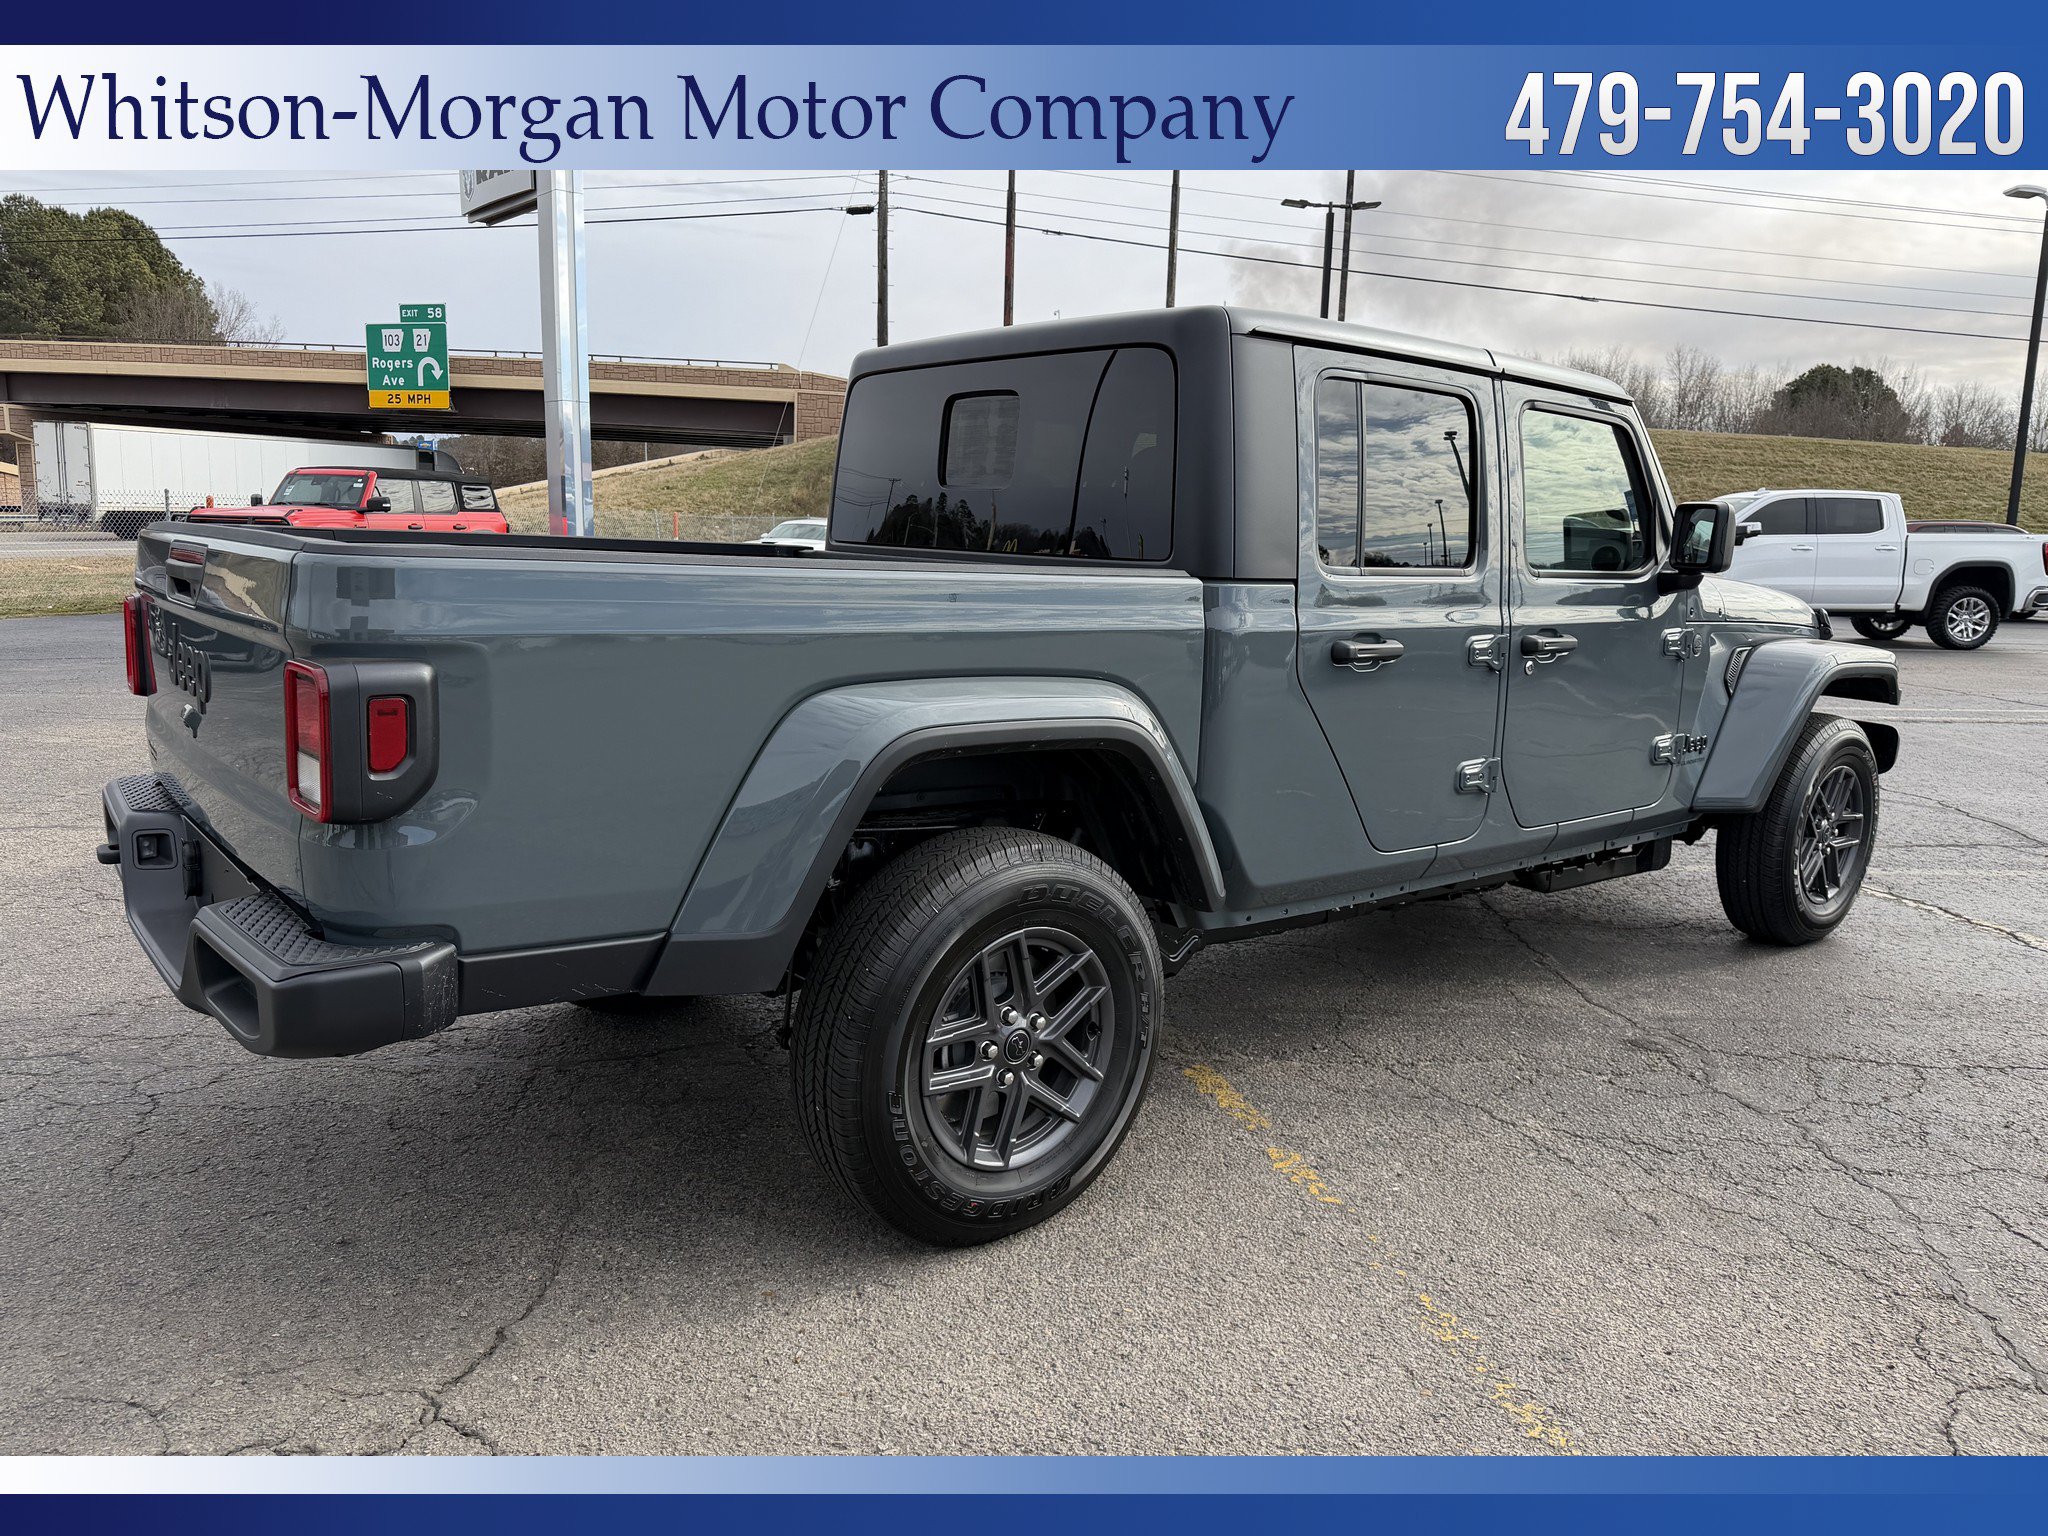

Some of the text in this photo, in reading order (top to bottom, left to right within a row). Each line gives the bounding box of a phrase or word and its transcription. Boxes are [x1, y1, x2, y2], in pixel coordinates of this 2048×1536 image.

[401, 307, 442, 318] EXIT 58
[384, 334, 400, 346] 103
[416, 334, 427, 346] 21
[372, 357, 413, 371] Rogers
[382, 375, 405, 385] Ave
[387, 394, 431, 404] 25 MPH
[1018, 883, 1146, 982] DUELER
[888, 1090, 1073, 1218] BRIDGESTONE
